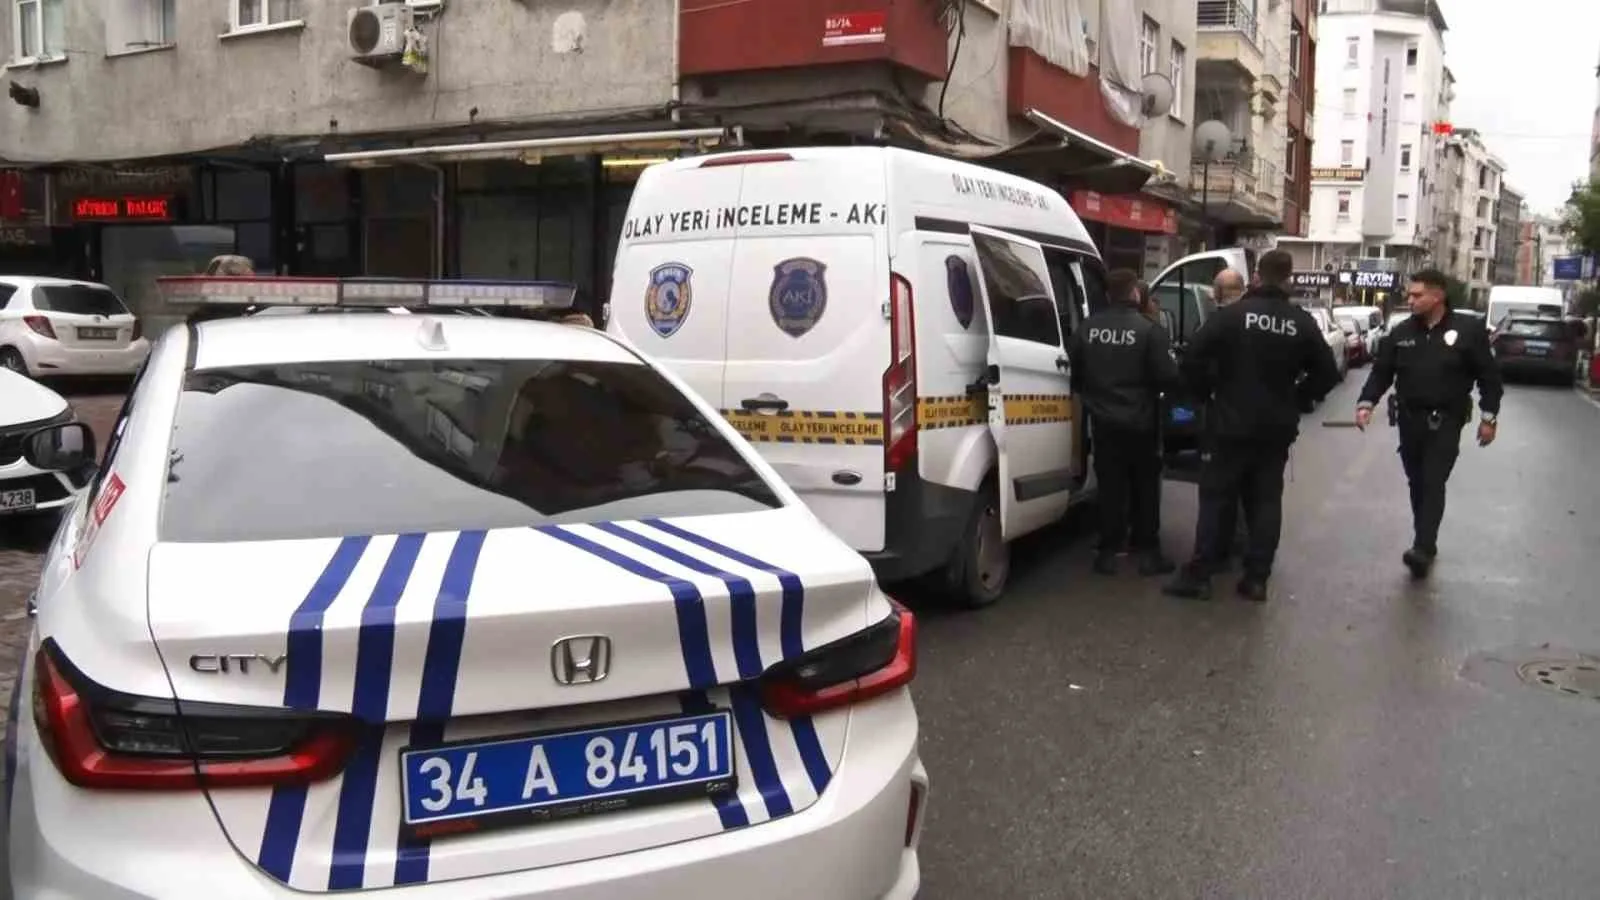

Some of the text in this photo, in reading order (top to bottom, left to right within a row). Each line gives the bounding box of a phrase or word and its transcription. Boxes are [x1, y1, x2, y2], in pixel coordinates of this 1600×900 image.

[625, 214, 664, 239] OLAY
[728, 419, 767, 432] CELEME
[189, 653, 288, 674] CITY
[419, 720, 719, 812] 34 A 84151
